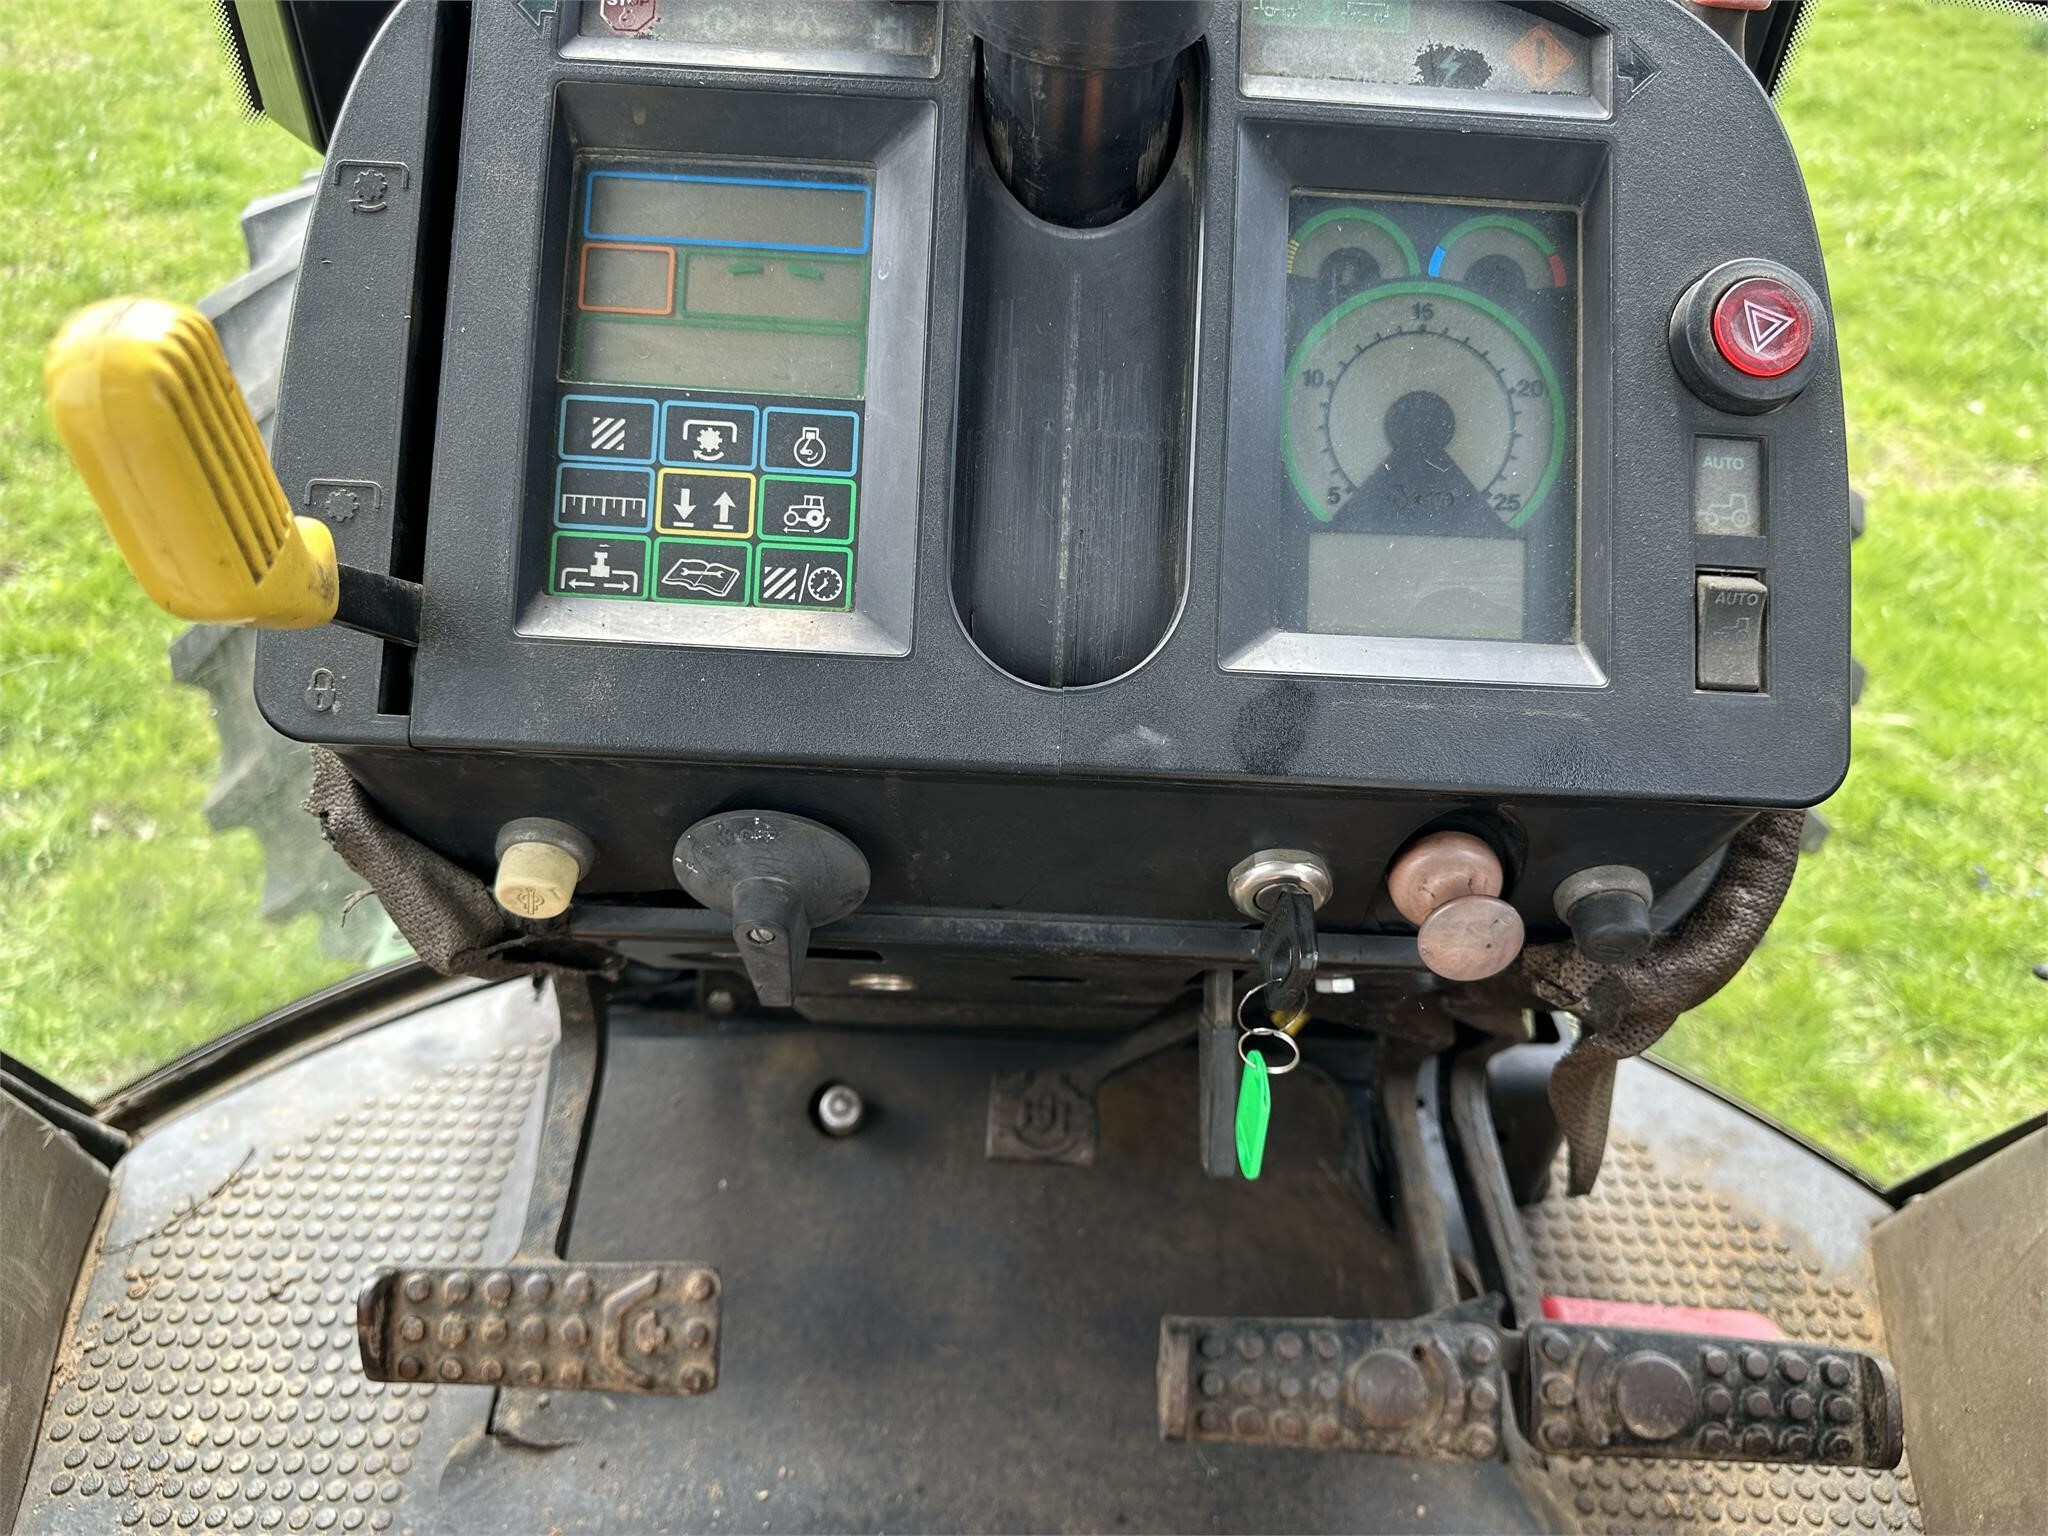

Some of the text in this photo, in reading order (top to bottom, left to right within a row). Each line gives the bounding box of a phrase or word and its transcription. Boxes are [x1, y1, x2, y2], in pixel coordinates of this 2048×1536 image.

[1412, 303, 1434, 321] 15
[1302, 369, 1324, 388] 10
[1516, 380, 1544, 398] 20
[1703, 456, 1745, 470] AUTO
[1326, 487, 1341, 506] 5
[1494, 495, 1522, 513] 25
[1715, 592, 1759, 606] AUTO
